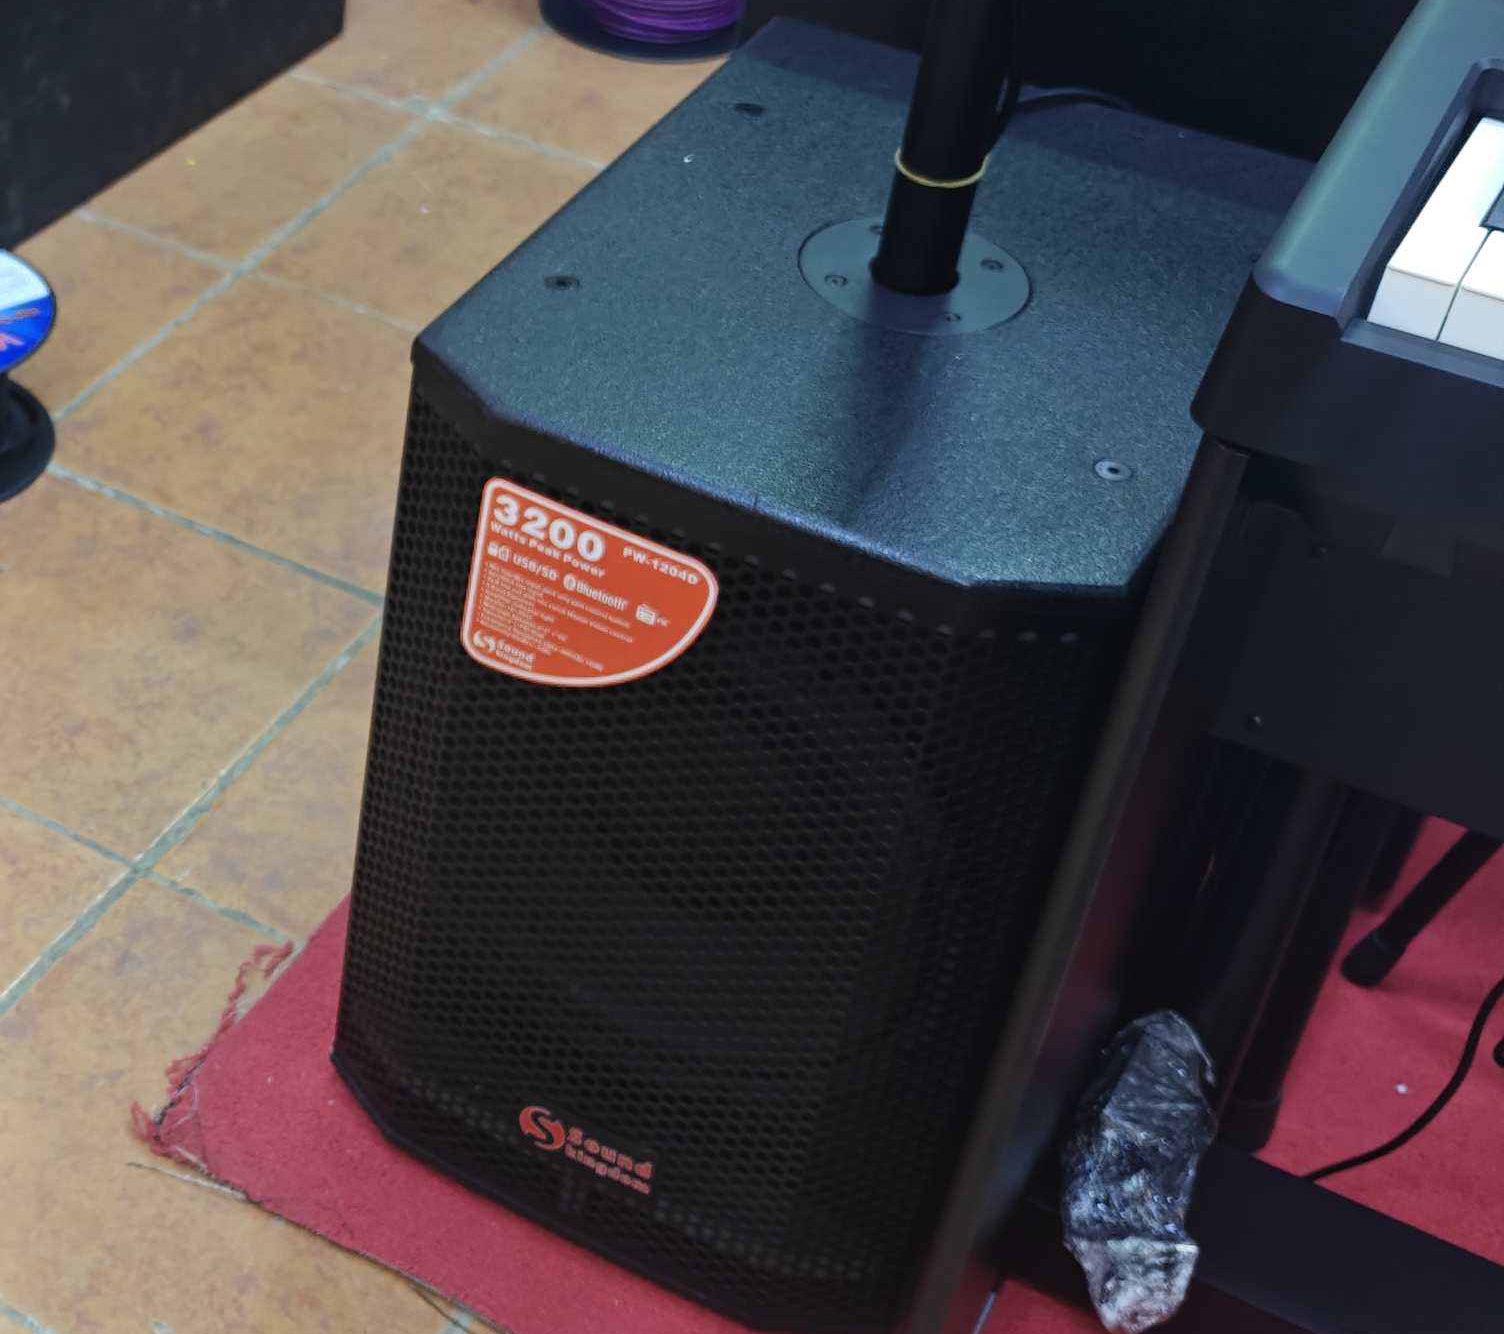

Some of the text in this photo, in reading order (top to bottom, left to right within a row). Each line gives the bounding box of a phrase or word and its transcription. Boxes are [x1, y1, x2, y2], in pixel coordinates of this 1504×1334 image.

[490, 521, 607, 578] Watts Peak Power
[492, 493, 608, 562] 3200
[512, 552, 559, 581] USB/SD
[575, 579, 629, 612] Bluetooth
[567, 1127, 653, 1180] Sound
